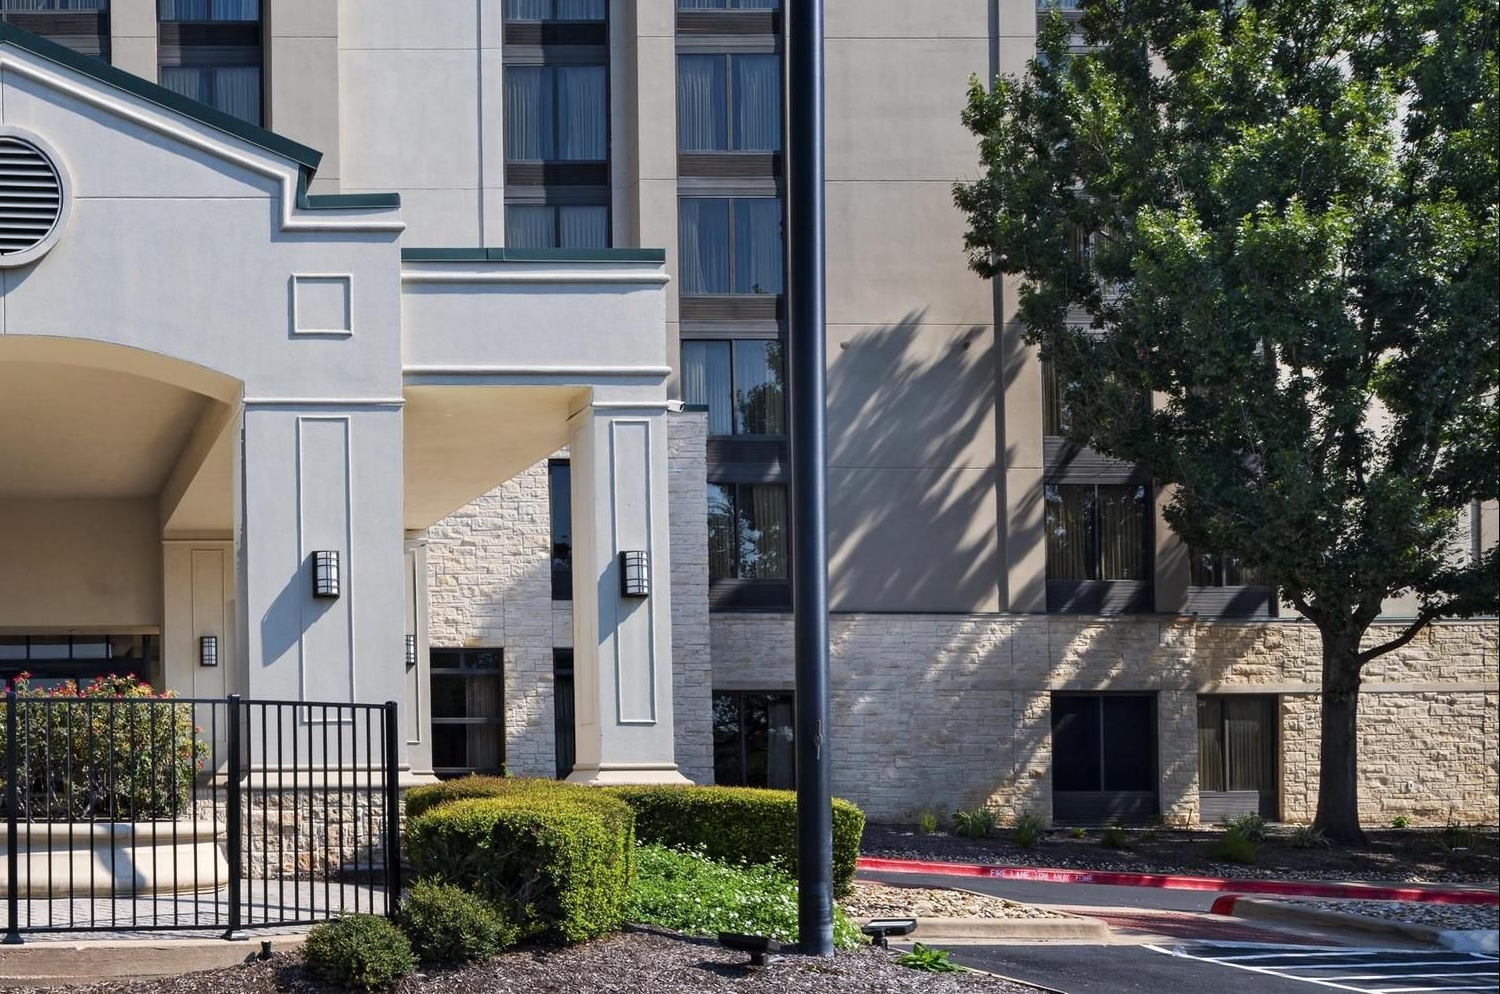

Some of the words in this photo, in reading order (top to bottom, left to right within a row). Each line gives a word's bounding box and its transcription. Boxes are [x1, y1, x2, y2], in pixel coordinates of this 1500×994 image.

[990, 868, 1007, 879] FIRE
[1010, 870, 1030, 880] LANE
[1052, 872, 1070, 883] AWAY
